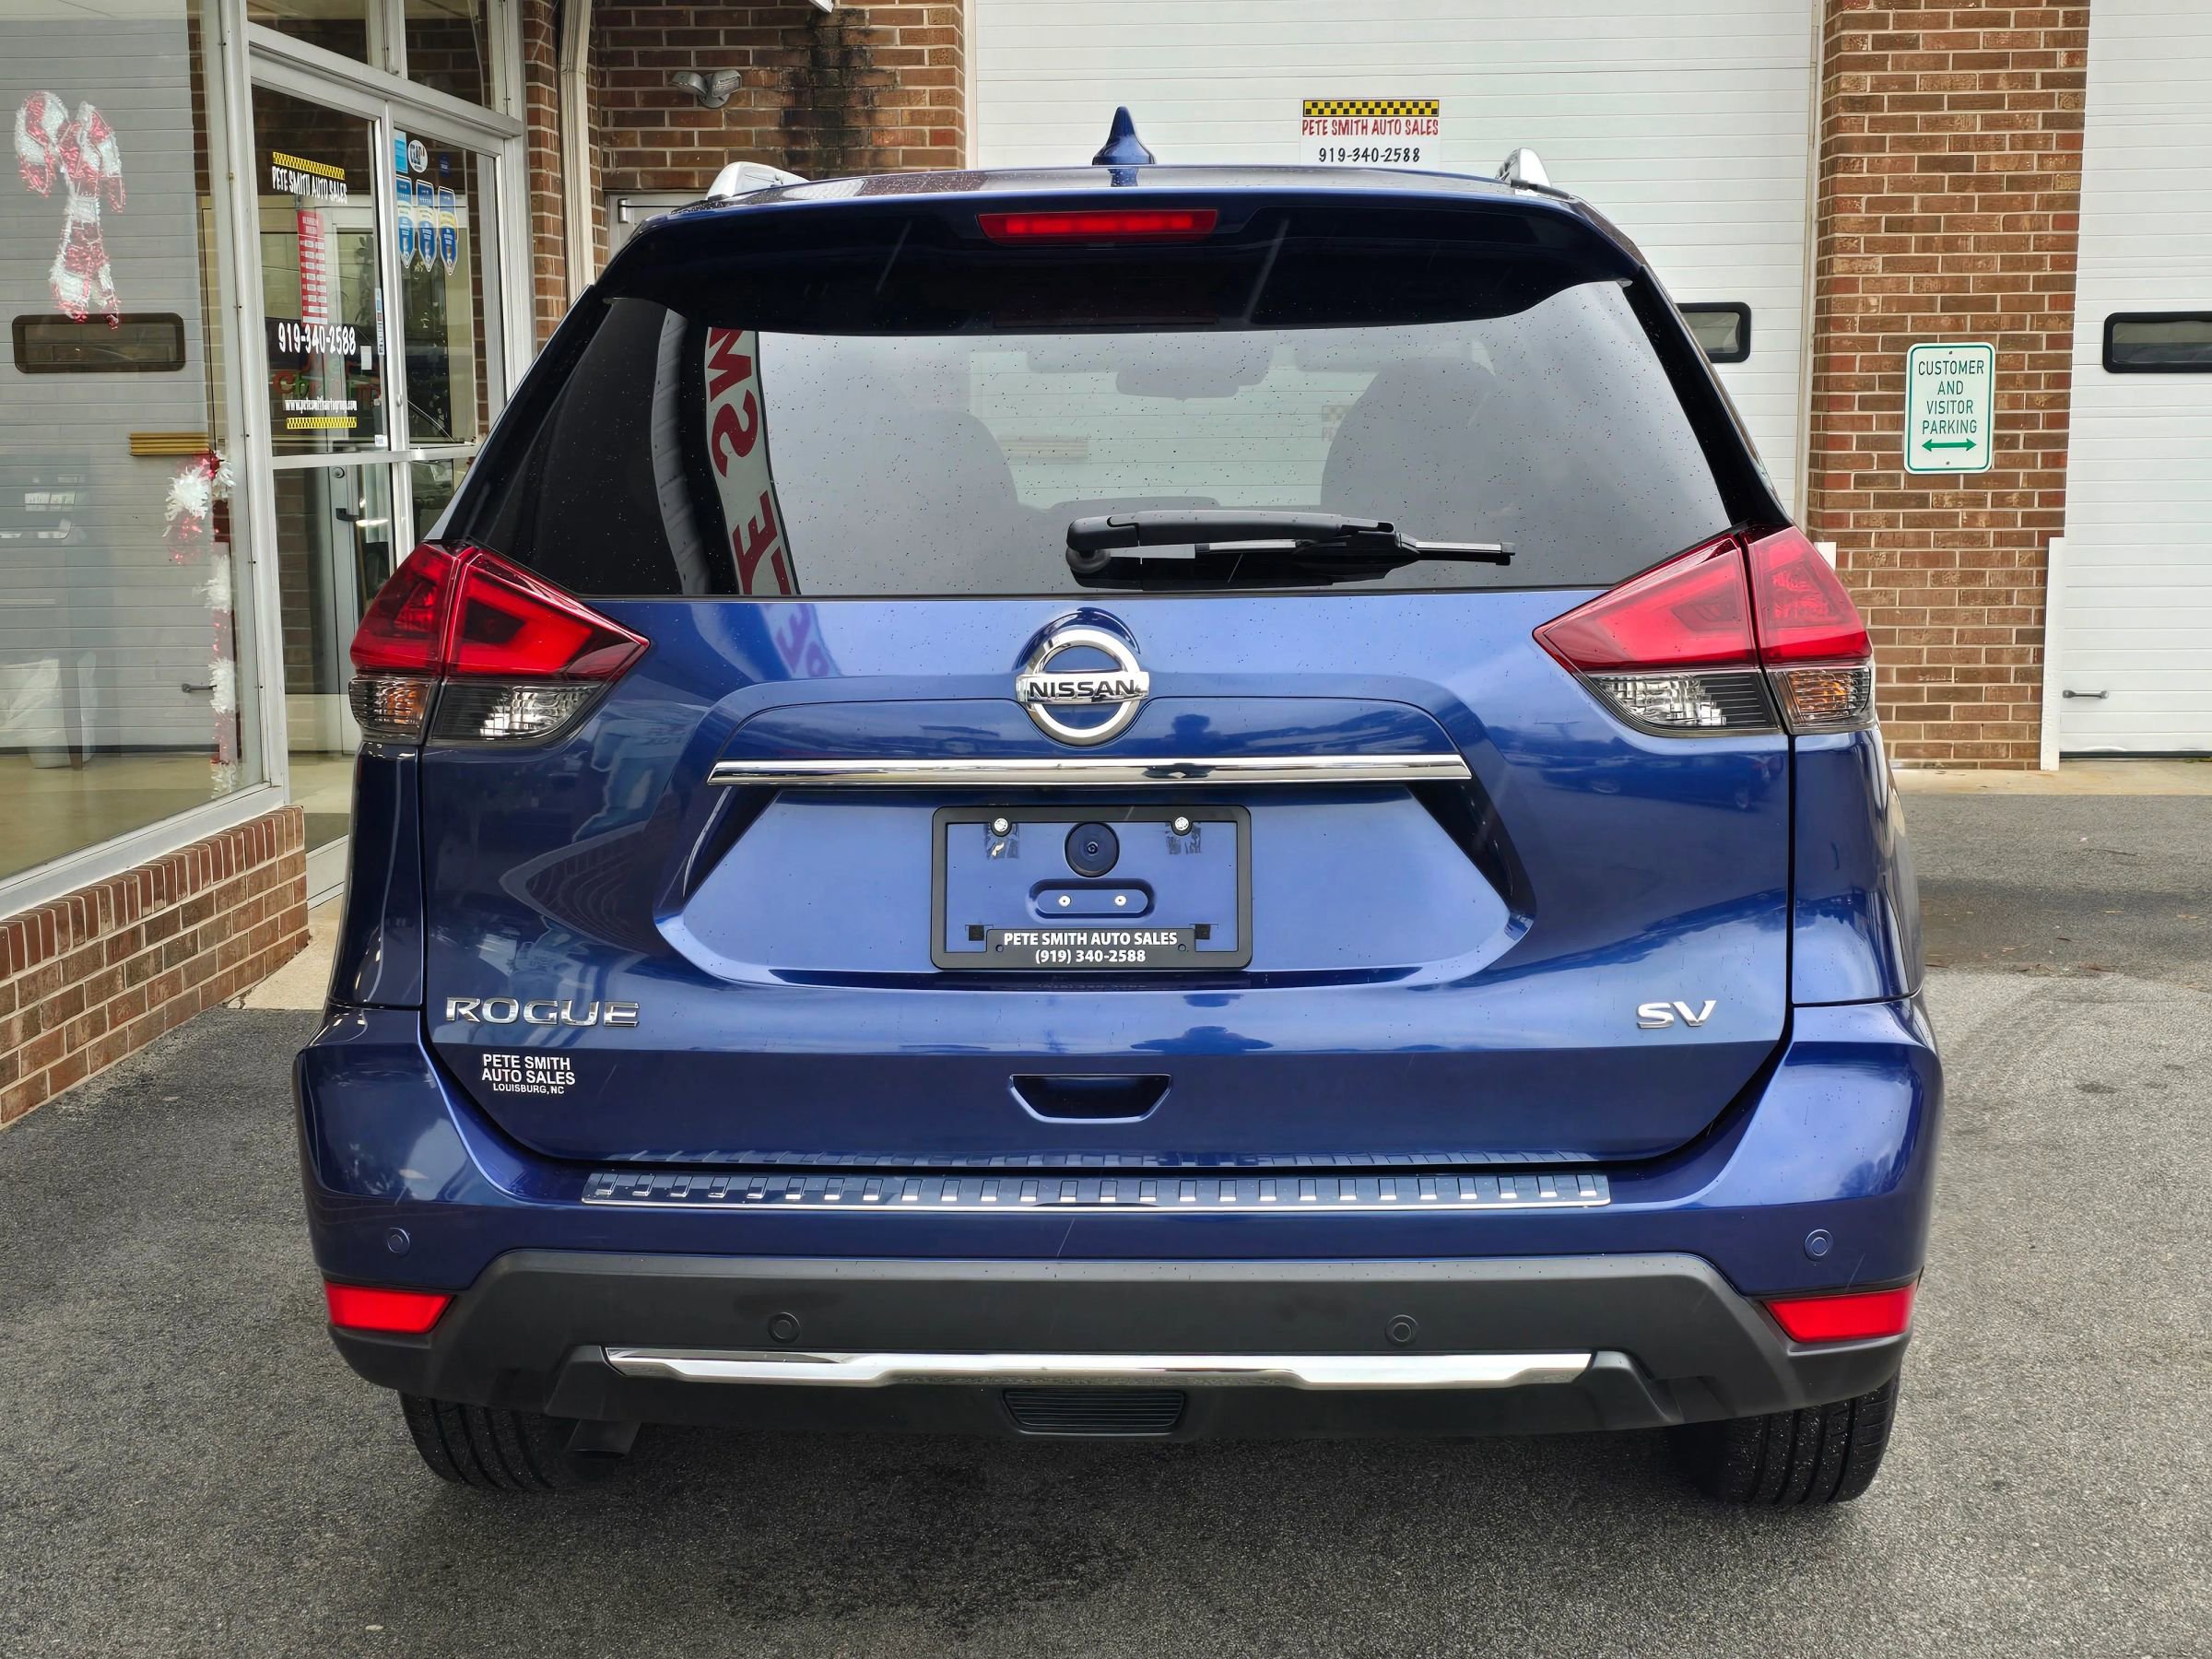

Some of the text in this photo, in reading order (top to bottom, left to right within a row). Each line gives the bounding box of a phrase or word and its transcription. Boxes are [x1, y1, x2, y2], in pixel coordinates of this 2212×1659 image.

[1301, 119, 1439, 136] PETE SMITH AUTO SALES
[1318, 147, 1420, 163] 919-340-2588
[272, 166, 347, 205] PETE SMITH AUTO SALES
[278, 322, 356, 356] 919-340-2588
[1918, 360, 1985, 376] CUSTOMER
[1936, 380, 1964, 395] AND
[1926, 399, 1973, 415] VISITOR
[1922, 419, 1978, 435] PARKING
[1029, 679, 1135, 699] NISSAN
[1004, 932, 1178, 946] PETE SMITH AUTO SALES
[1035, 948, 1147, 964] (919) 340-2588
[446, 996, 641, 1028] ROGUE
[1636, 999, 1717, 1030] SV
[482, 1053, 571, 1071] PETE SMITH
[481, 1067, 576, 1086] AUTO SALES
[550, 1086, 565, 1095] NC
